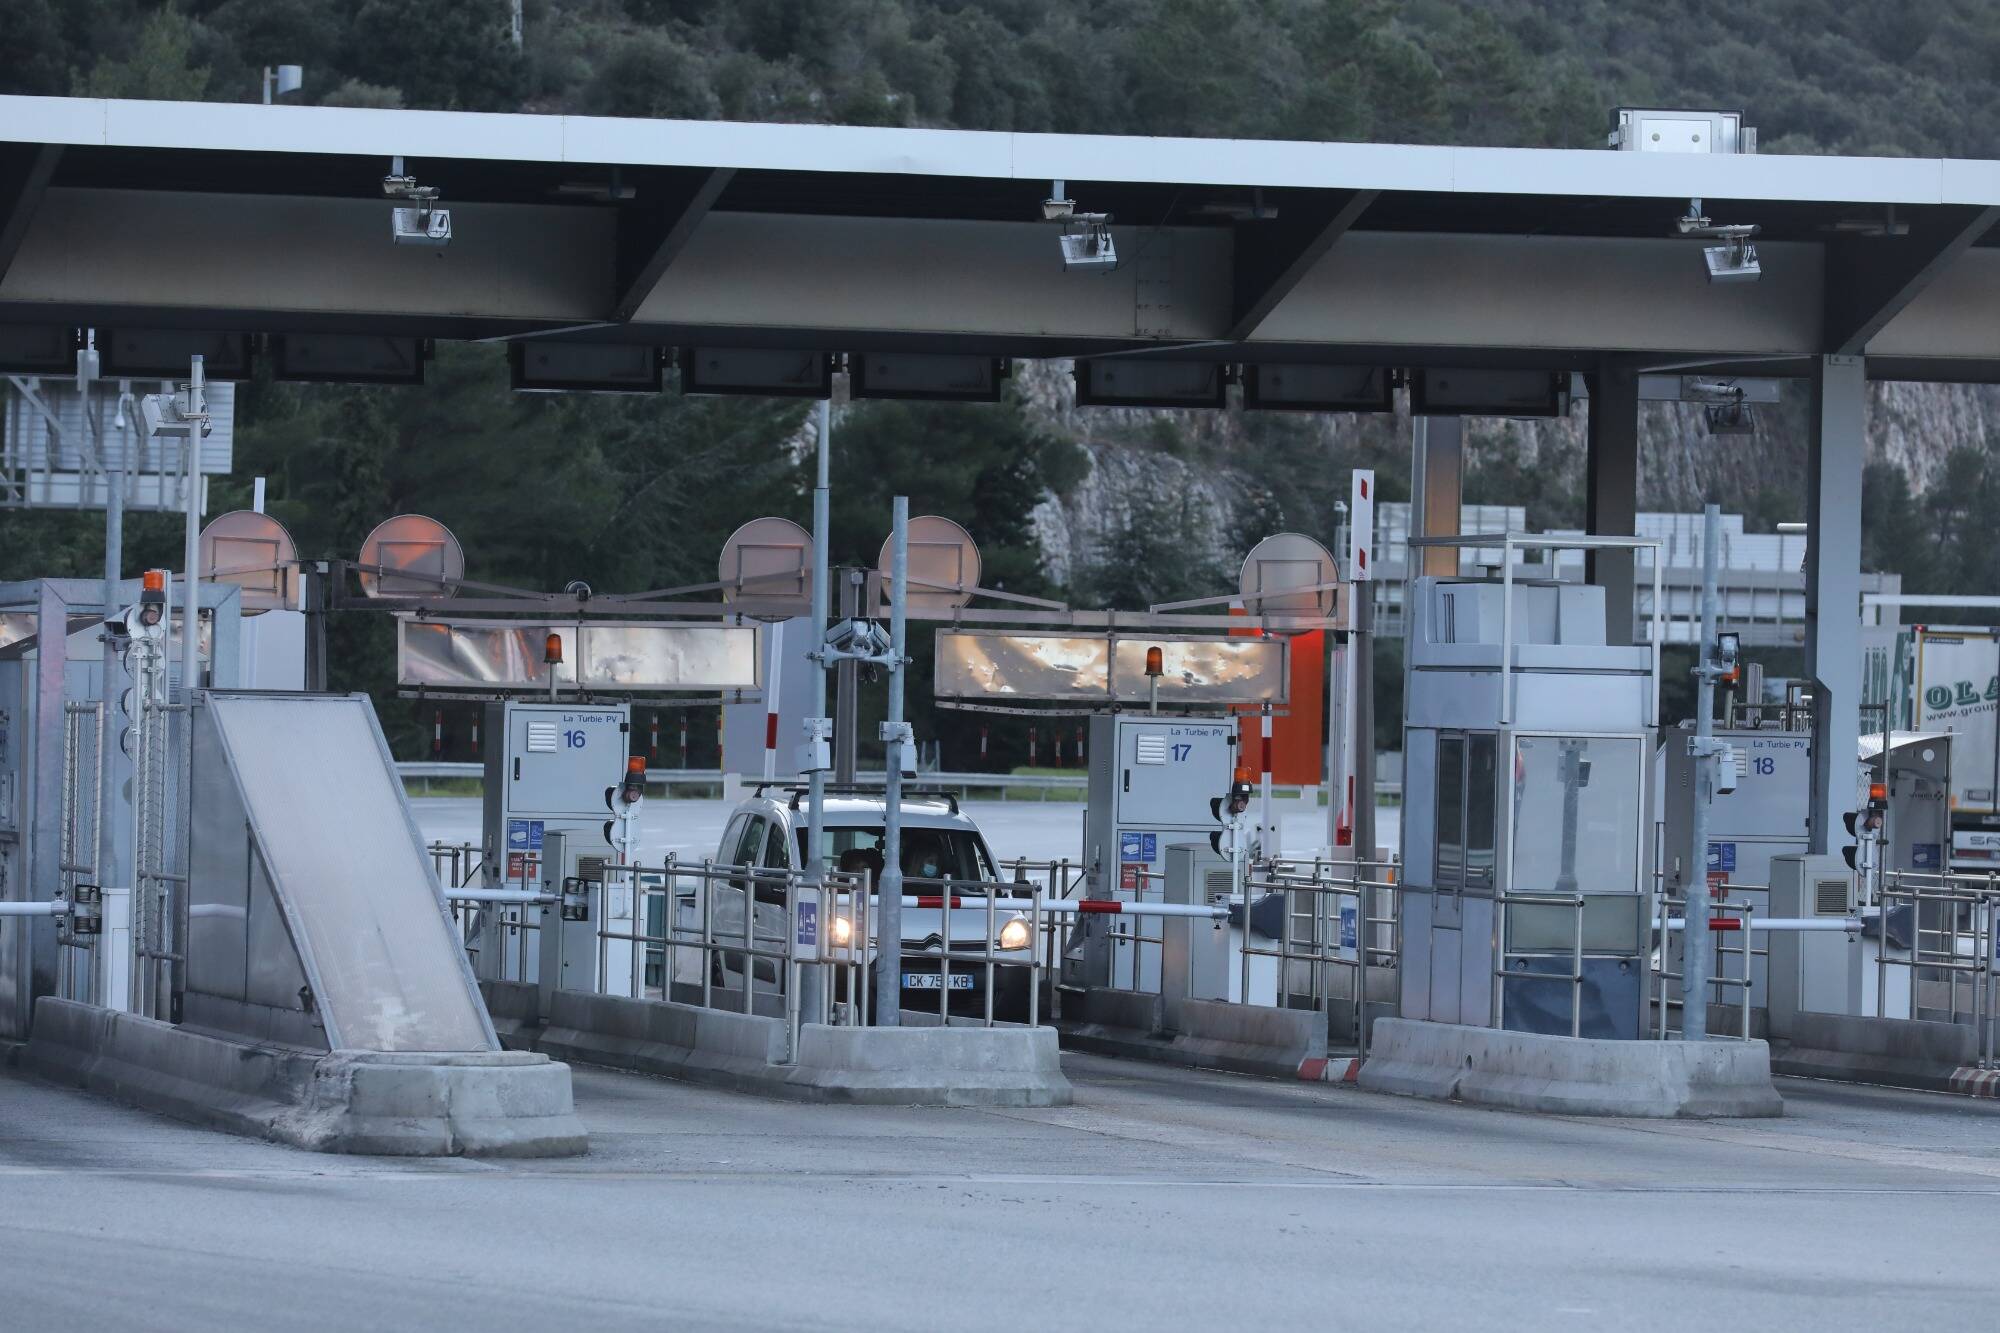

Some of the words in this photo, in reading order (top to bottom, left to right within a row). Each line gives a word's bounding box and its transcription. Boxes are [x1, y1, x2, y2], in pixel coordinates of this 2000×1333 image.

[578, 715, 602, 723] Turbie
[1184, 728, 1208, 736] Turbie
[563, 730, 586, 748] 16
[1754, 740, 1763, 748] La
[1767, 740, 1790, 748] Turbie
[1171, 744, 1192, 761] 17
[1753, 757, 1774, 775] 18
